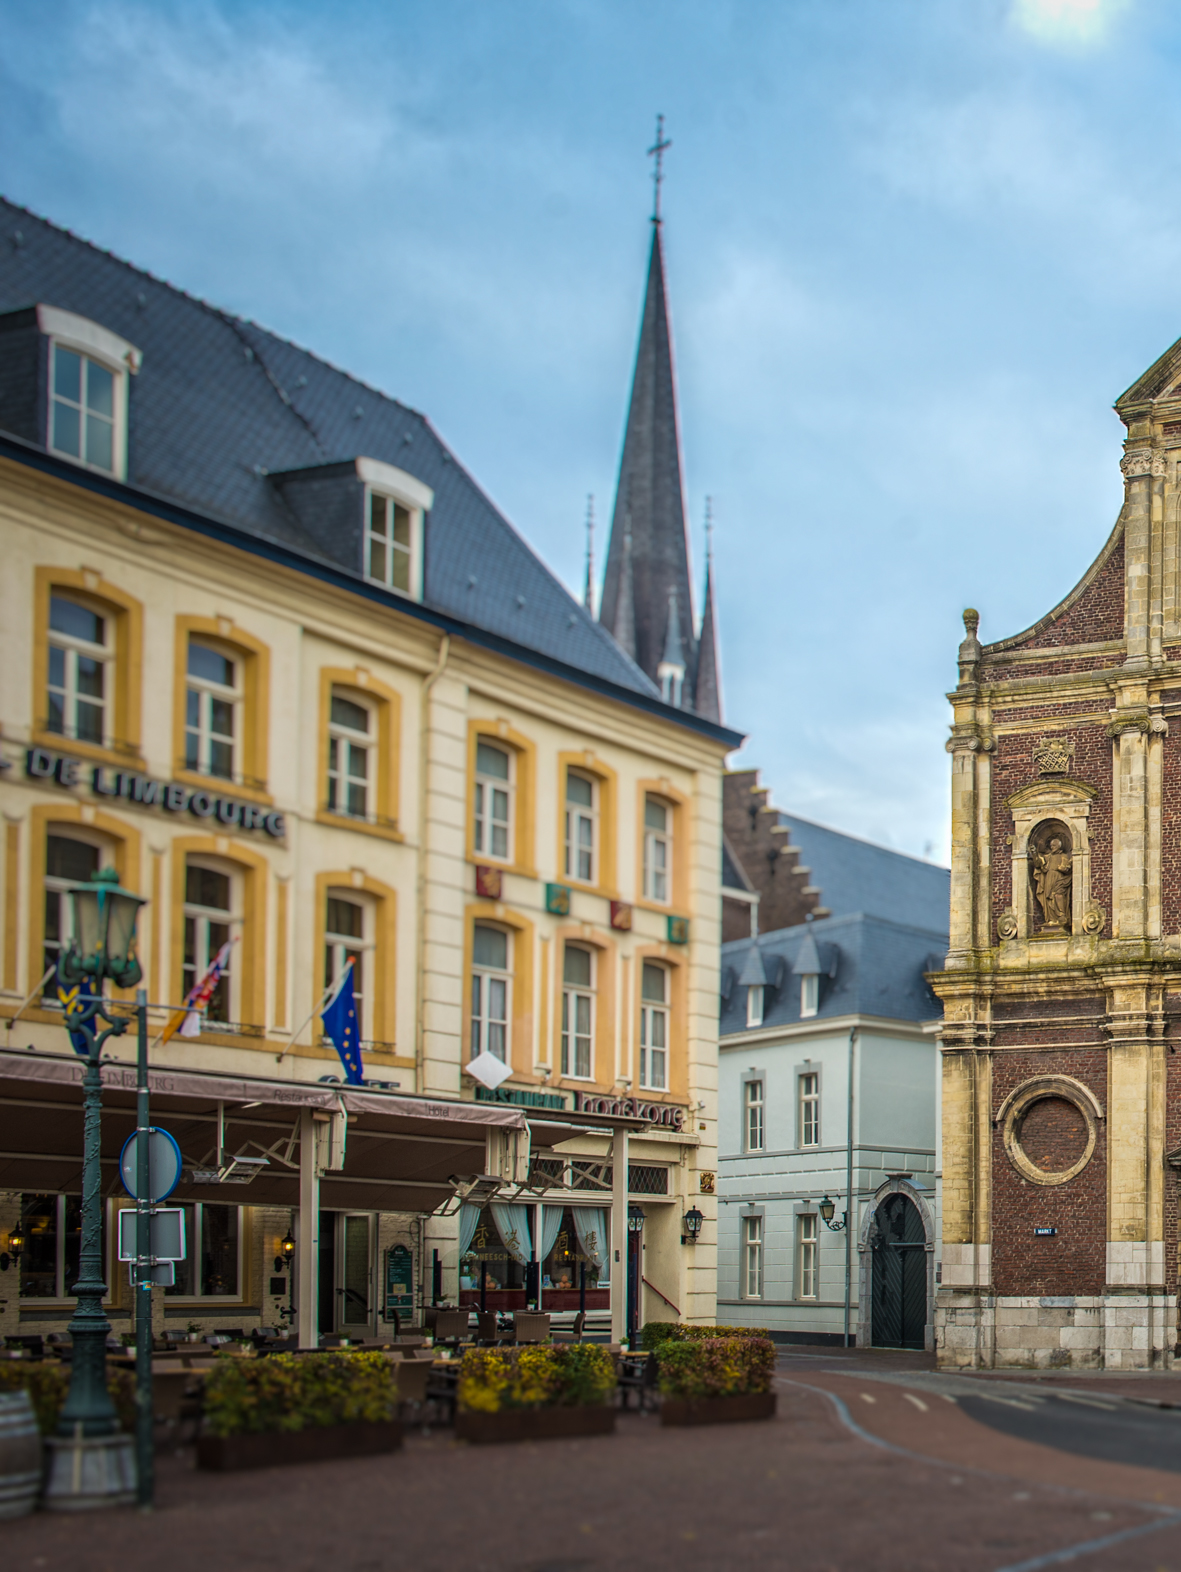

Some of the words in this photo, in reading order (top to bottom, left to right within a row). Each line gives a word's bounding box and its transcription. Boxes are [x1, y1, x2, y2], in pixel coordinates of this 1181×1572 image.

[27, 748, 80, 787] DE
[93, 766, 287, 838] LIMBOURG
[428, 1104, 449, 1117] Hotel
